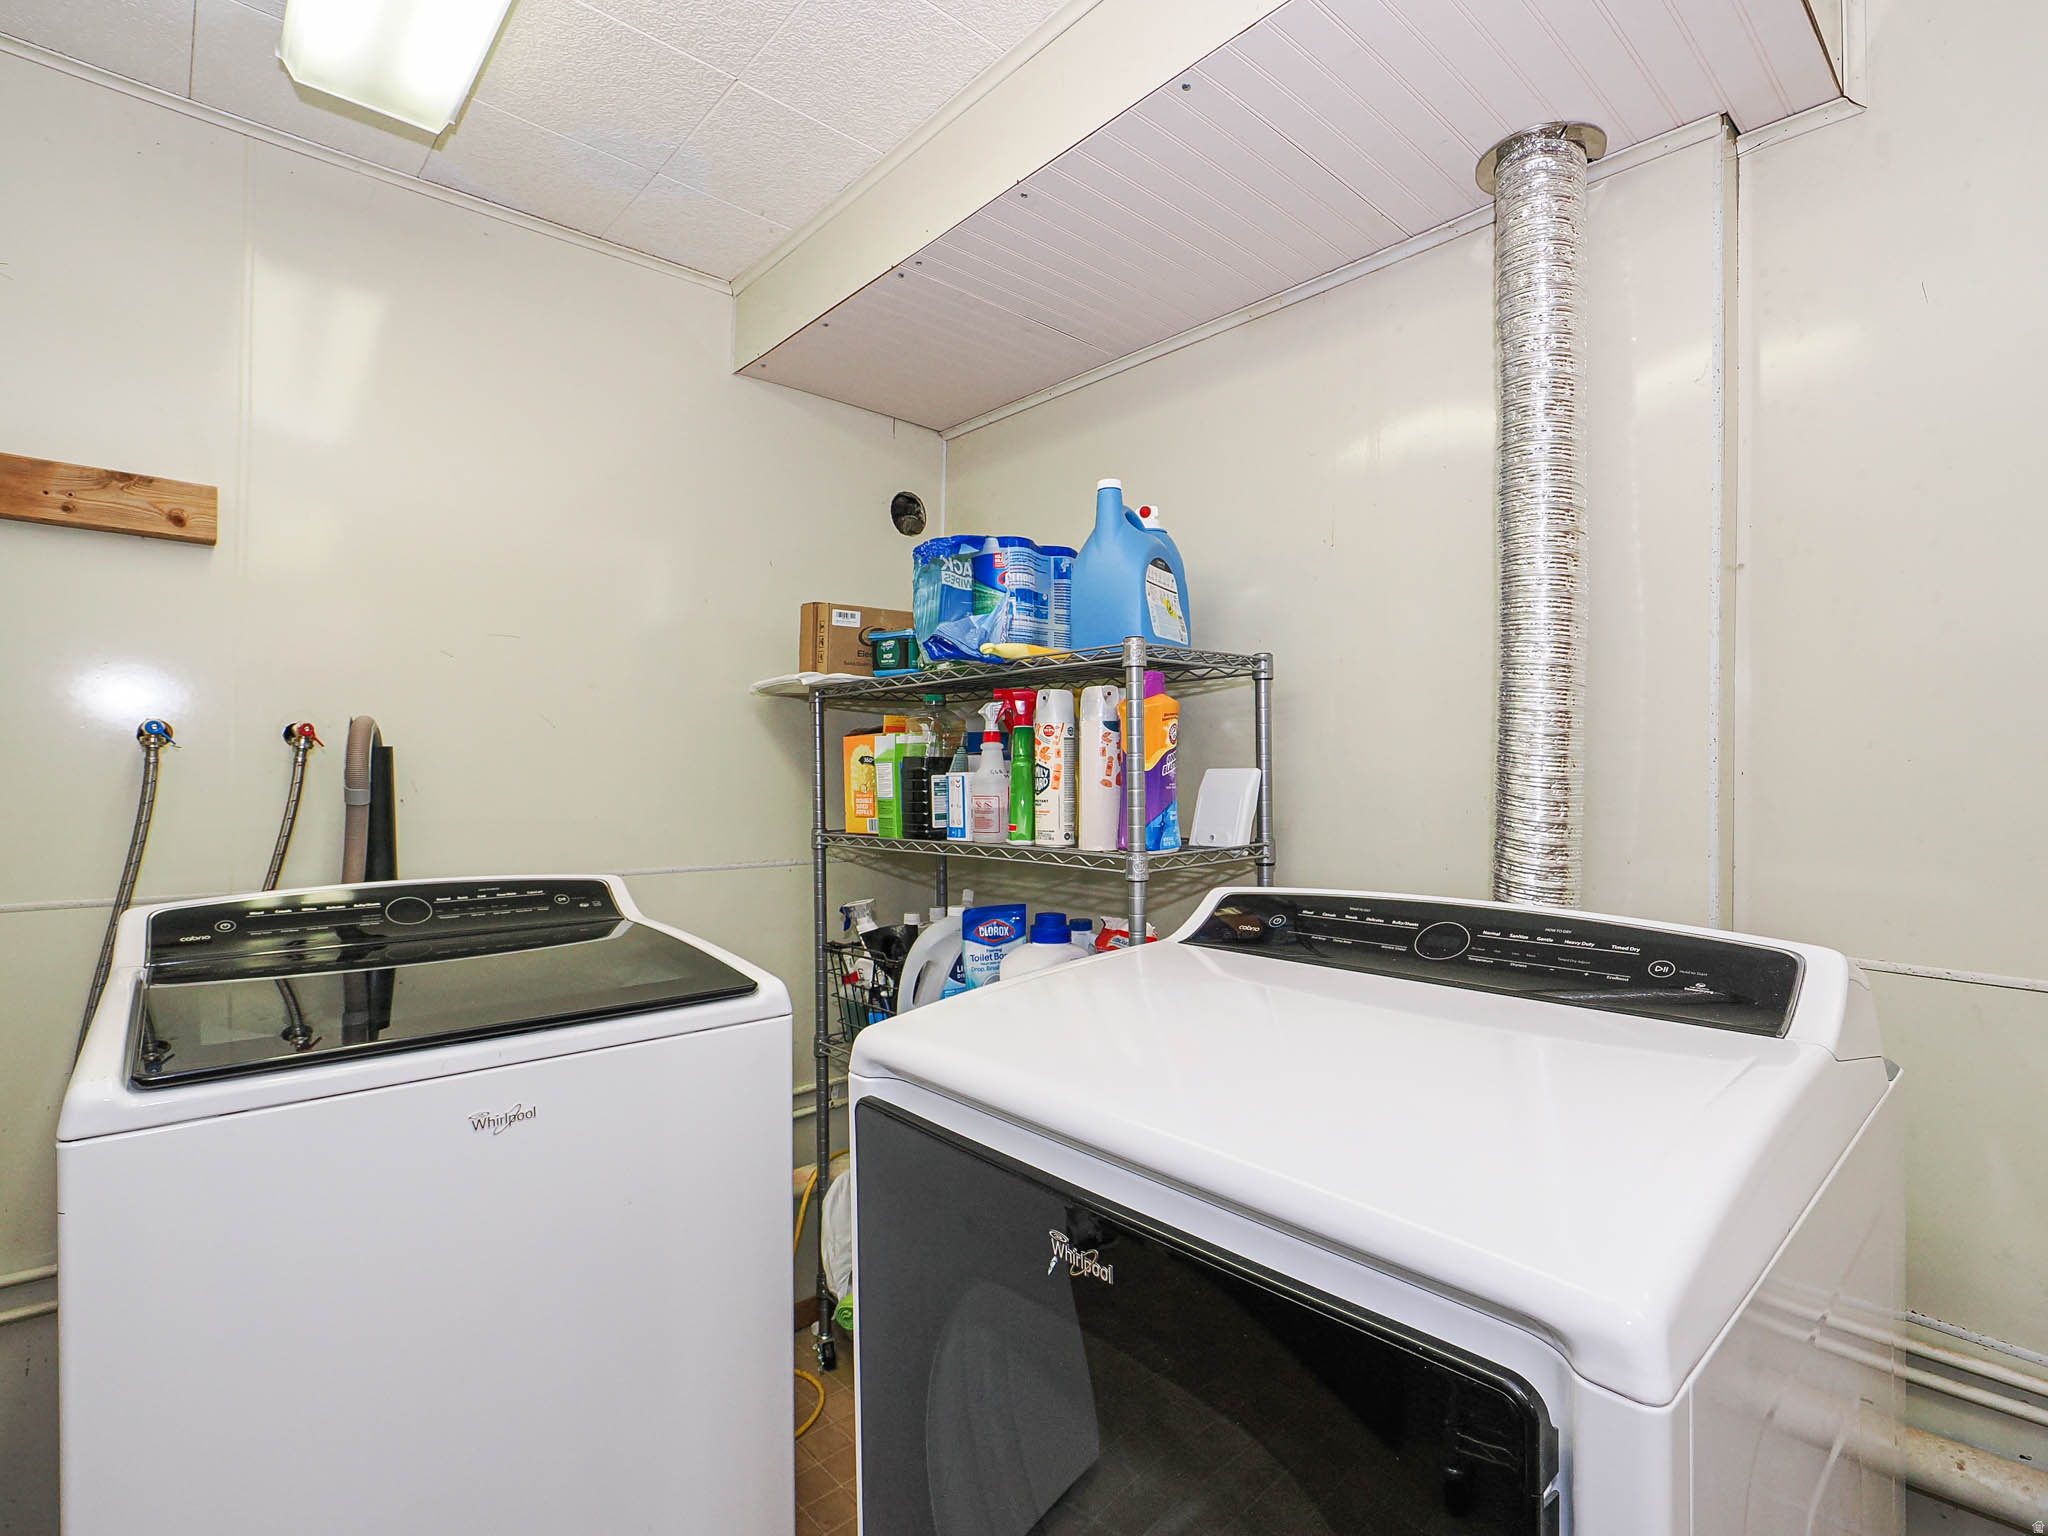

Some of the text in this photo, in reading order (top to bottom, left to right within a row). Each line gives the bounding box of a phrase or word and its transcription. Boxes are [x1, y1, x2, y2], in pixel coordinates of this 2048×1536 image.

[978, 926, 1010, 937] CLOROX
[1564, 939, 1581, 947] Heavy
[1611, 944, 1629, 952] Timed
[969, 953, 993, 962] Toilet
[470, 1104, 537, 1133] Whirlpool
[1050, 1236, 1114, 1286] Whirlpool
